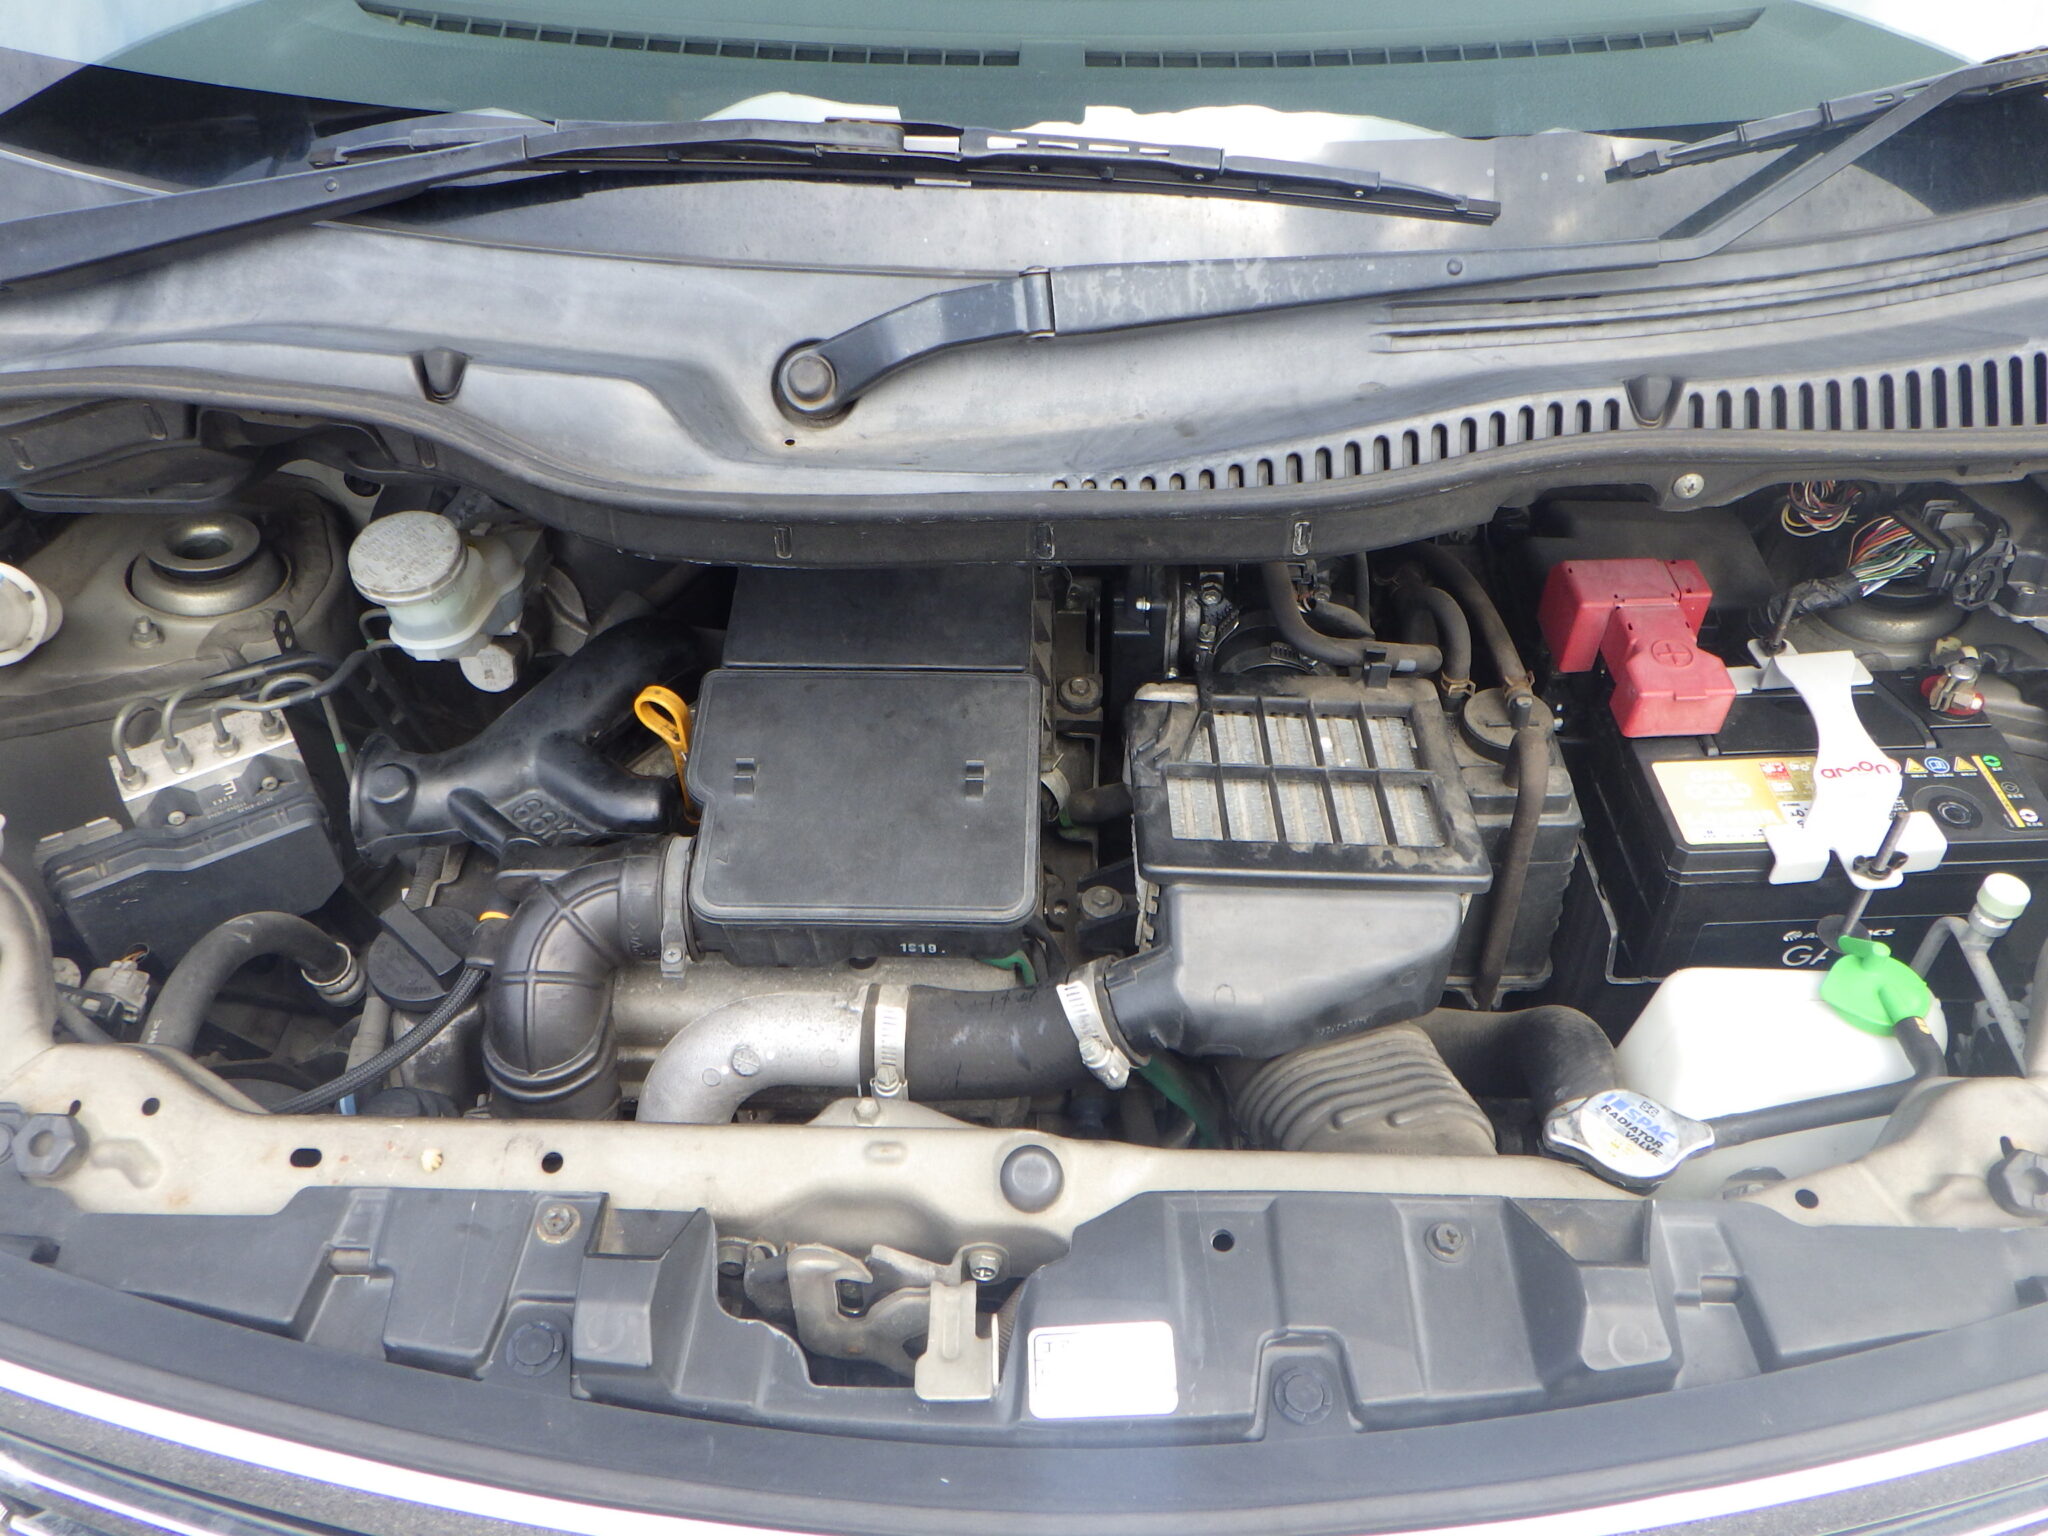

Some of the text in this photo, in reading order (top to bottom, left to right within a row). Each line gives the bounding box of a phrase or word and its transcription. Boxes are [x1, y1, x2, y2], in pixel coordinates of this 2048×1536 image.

[1820, 760, 1891, 779] amon
[1600, 1104, 1664, 1149] RADIATOR
[1624, 1131, 1664, 1158] VALVE
